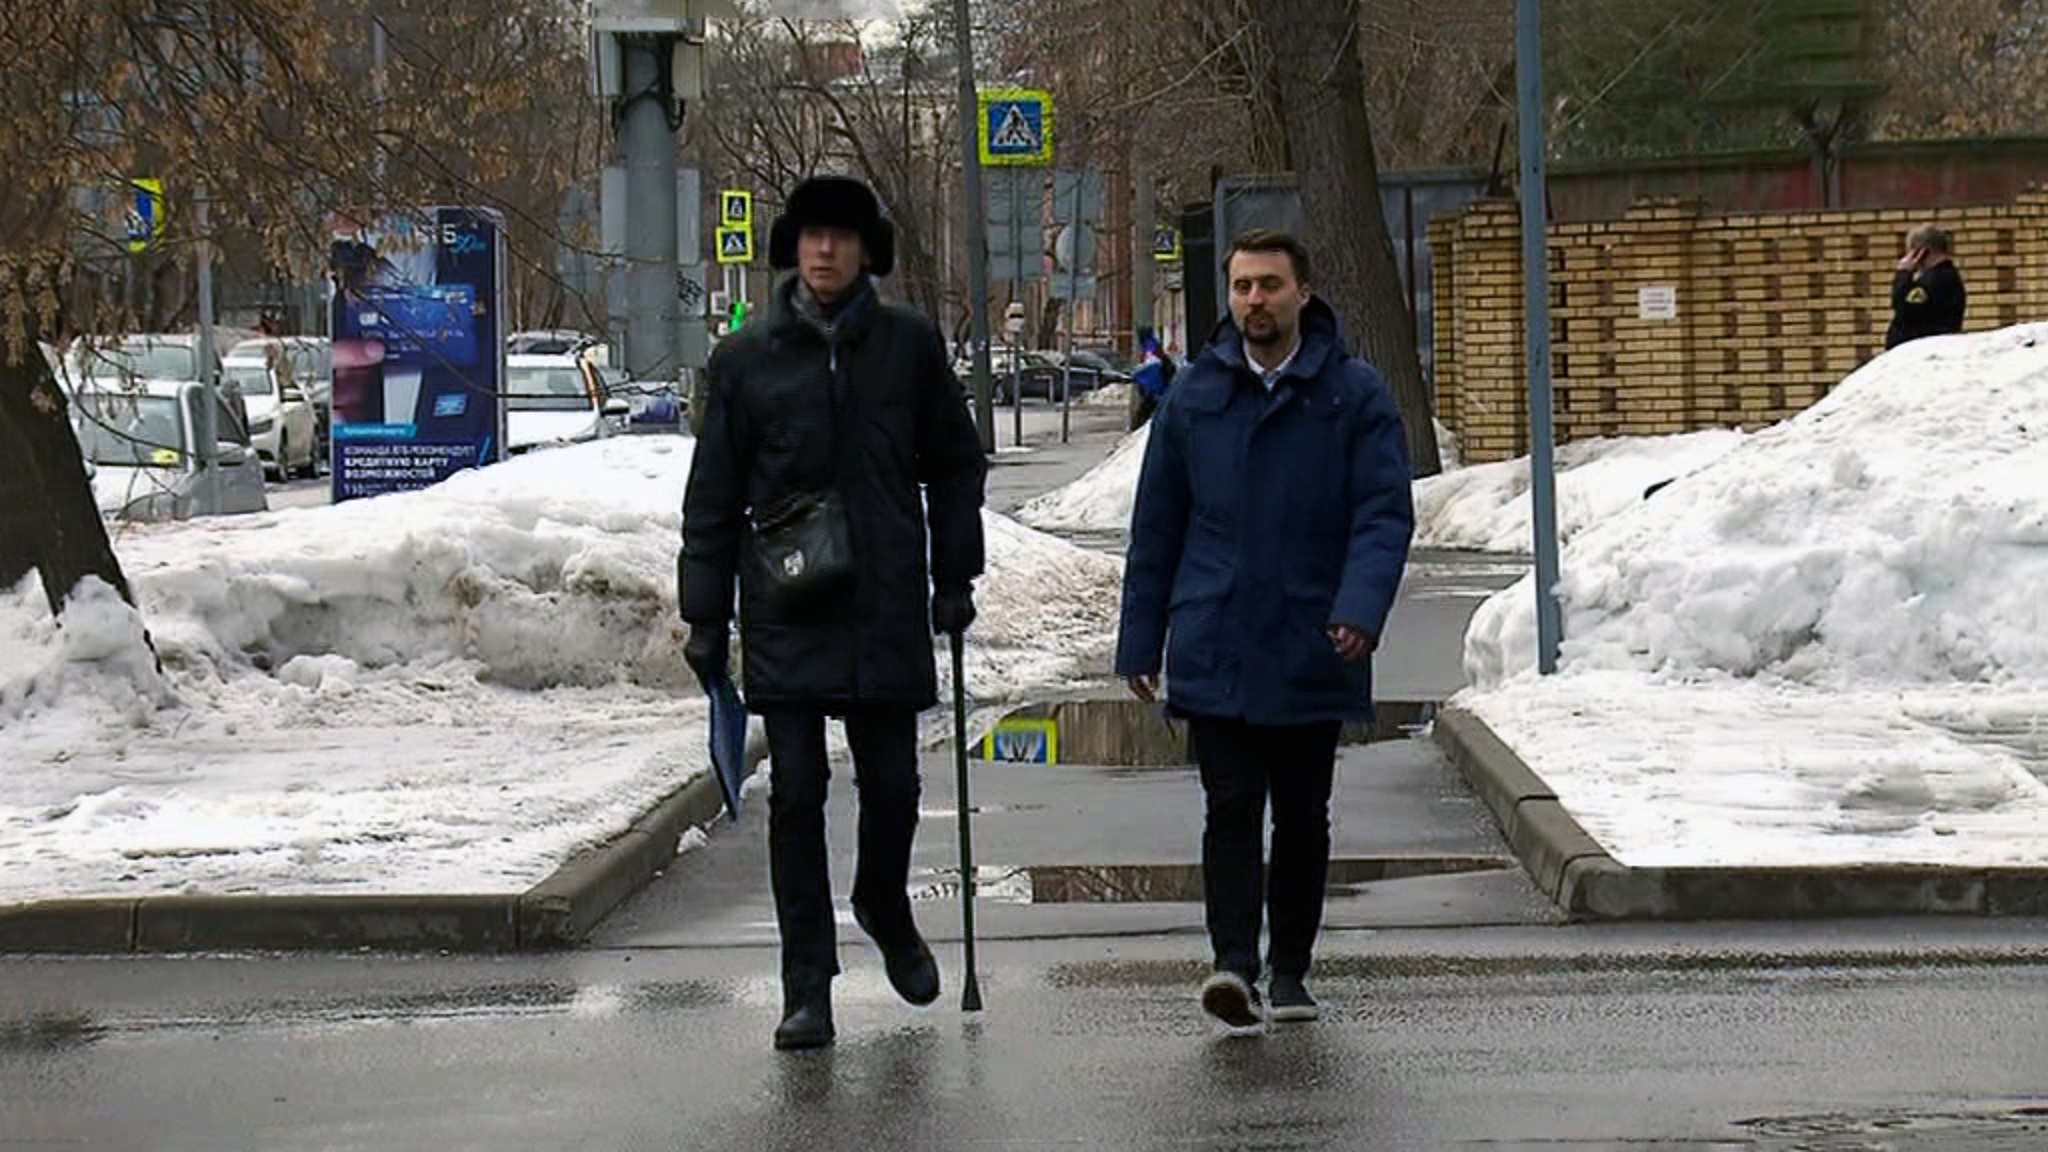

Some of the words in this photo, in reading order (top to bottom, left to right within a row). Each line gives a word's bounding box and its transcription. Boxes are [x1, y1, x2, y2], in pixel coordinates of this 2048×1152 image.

[343, 457, 411, 467] КРЕДИТНУЮ
[414, 457, 449, 467] КАРТУ
[343, 467, 436, 479] ВОЗМОЖНОСТЕЙ
